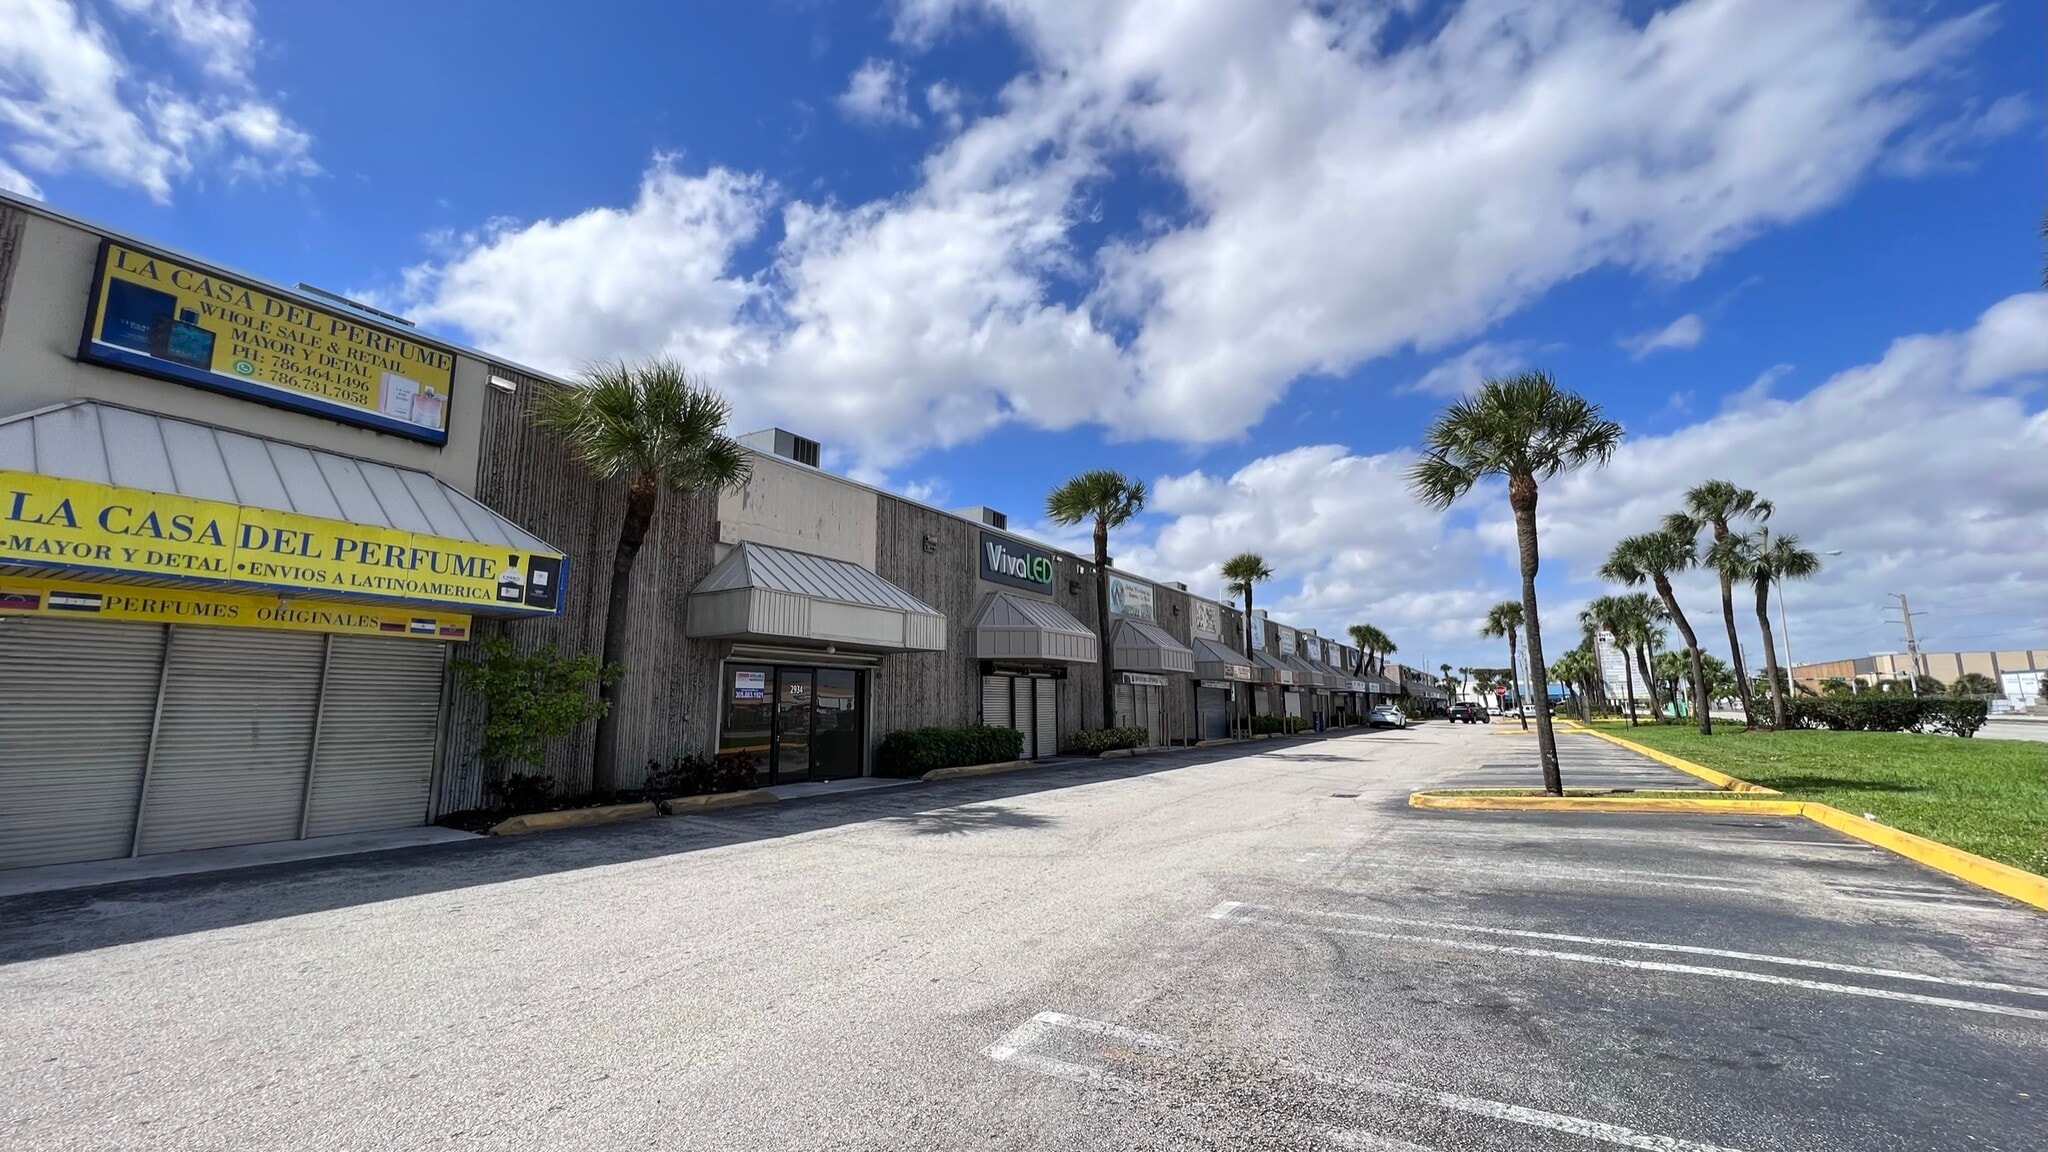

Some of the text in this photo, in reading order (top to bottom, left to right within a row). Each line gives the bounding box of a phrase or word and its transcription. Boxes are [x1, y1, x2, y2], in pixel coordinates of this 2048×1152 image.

[113, 249, 451, 372] LA CASA DEL PERFUME
[200, 301, 406, 375] WHOLE SALE & RETAIL
[231, 328, 373, 379] MAYOR Y DETAL
[269, 369, 369, 405] 786.731.7058
[271, 355, 370, 392] 786.464.1496
[5, 491, 497, 580] LA CASA DEL PERFUME
[121, 547, 140, 563] Y
[144, 550, 228, 573] DETAL
[985, 541, 1053, 585] VivaLED
[332, 572, 345, 585] A
[350, 573, 492, 600] LATINOAMERICA
[104, 595, 379, 629] PERFUMES ORIGINALES
[790, 684, 803, 694] 2934
